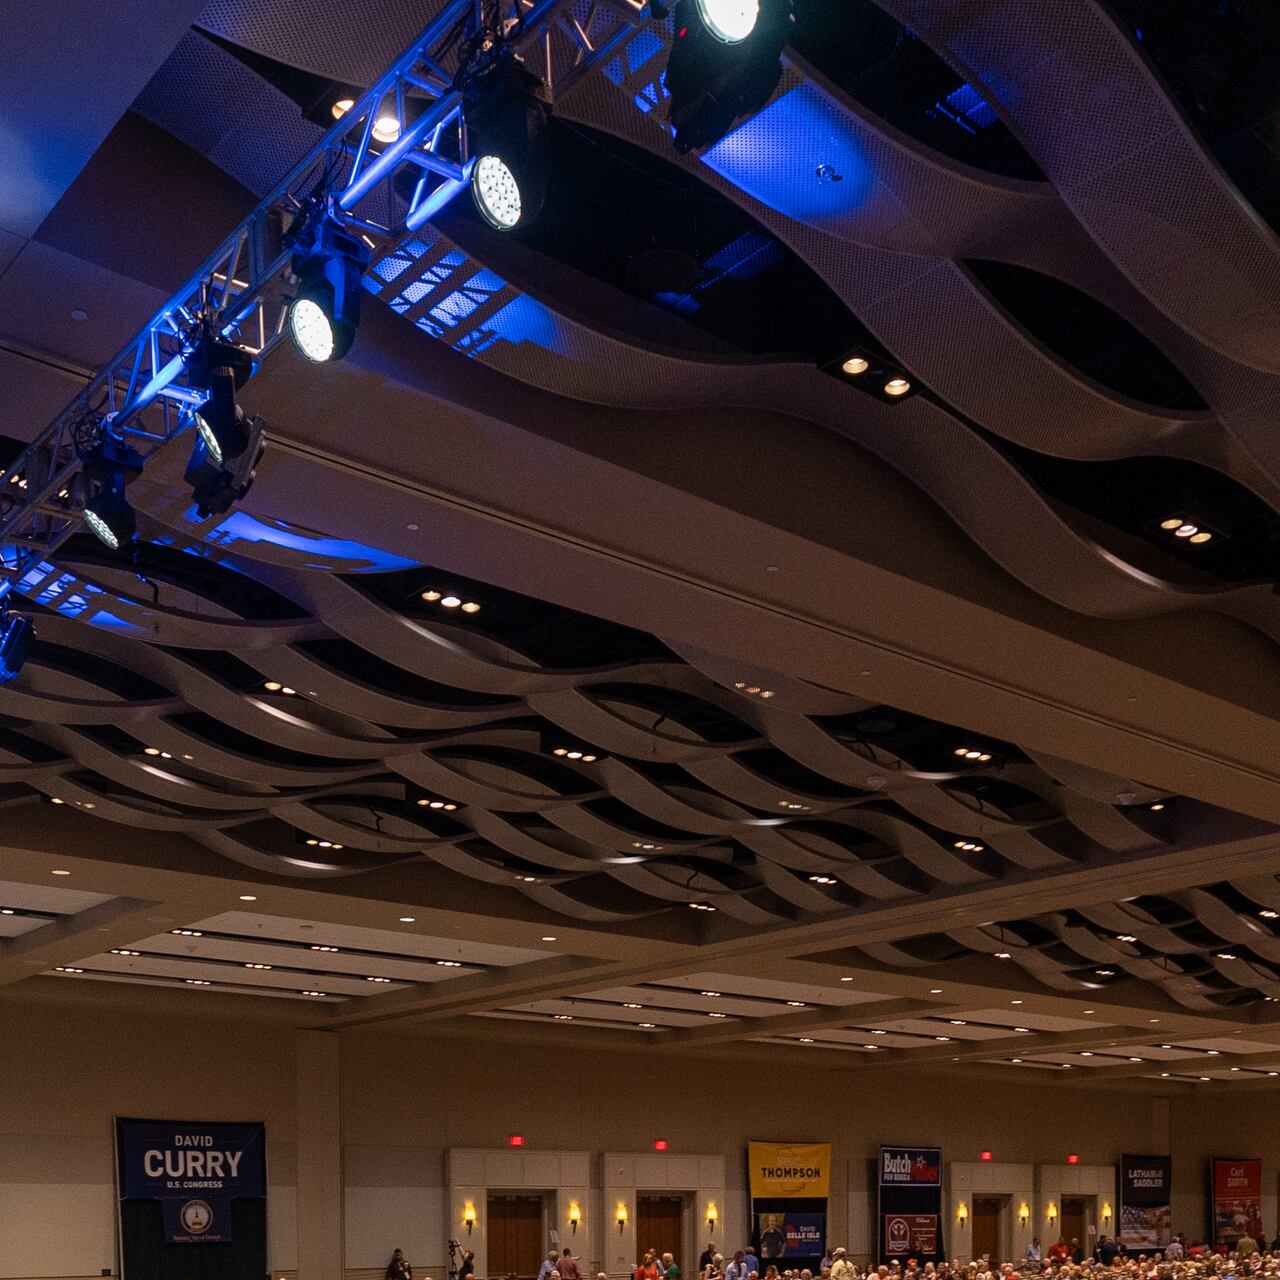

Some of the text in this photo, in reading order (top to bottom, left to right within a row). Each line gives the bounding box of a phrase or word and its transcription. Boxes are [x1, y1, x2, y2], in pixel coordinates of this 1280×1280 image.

[175, 1135, 213, 1146] DAVID
[144, 1149, 242, 1177] CURRY
[884, 1152, 911, 1173] Butch
[761, 1167, 821, 1178] THOMPSON
